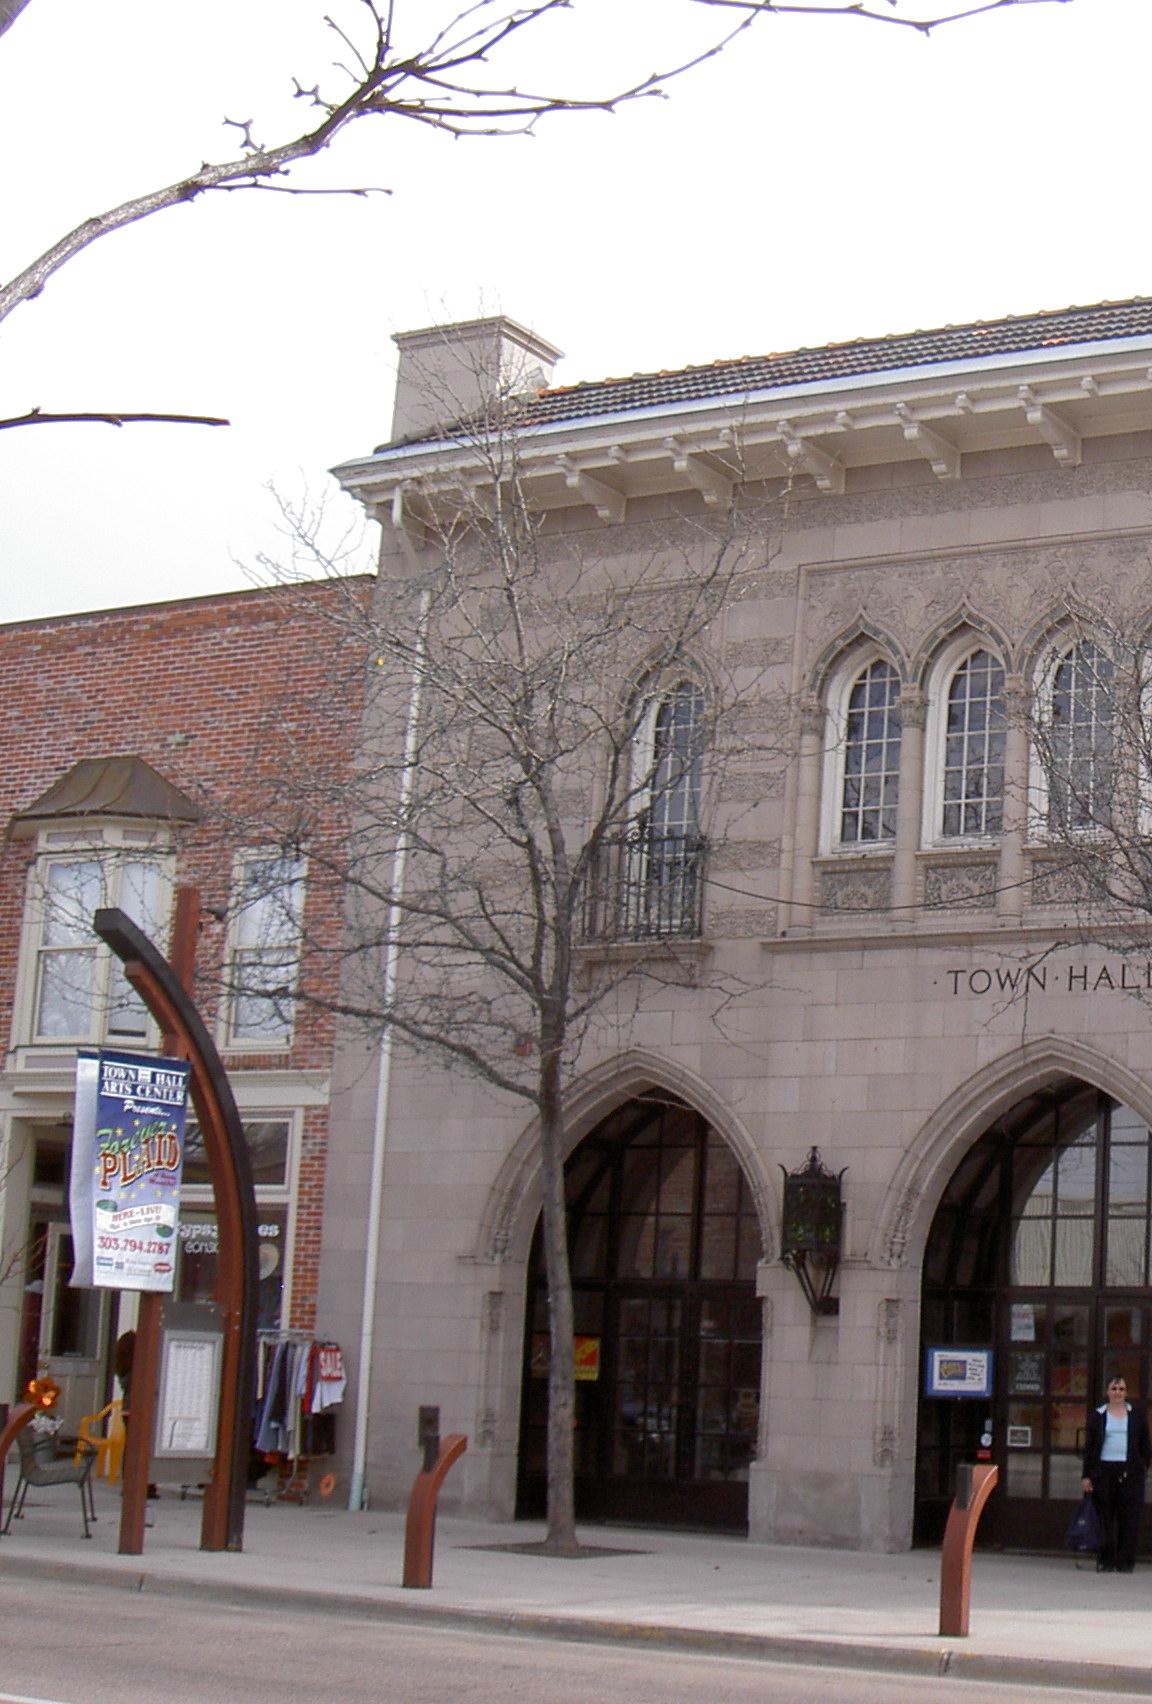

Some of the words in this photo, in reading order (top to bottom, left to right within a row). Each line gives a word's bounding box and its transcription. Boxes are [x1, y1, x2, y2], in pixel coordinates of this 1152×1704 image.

[947, 966, 1047, 995] TOWN
[102, 1065, 136, 1081] TOWN
[155, 1072, 184, 1088] HALL
[102, 1080, 132, 1095] ARTS
[136, 1084, 185, 1102] CENTER
[99, 1131, 181, 1191] PLAID
[319, 1351, 342, 1369] SALE
